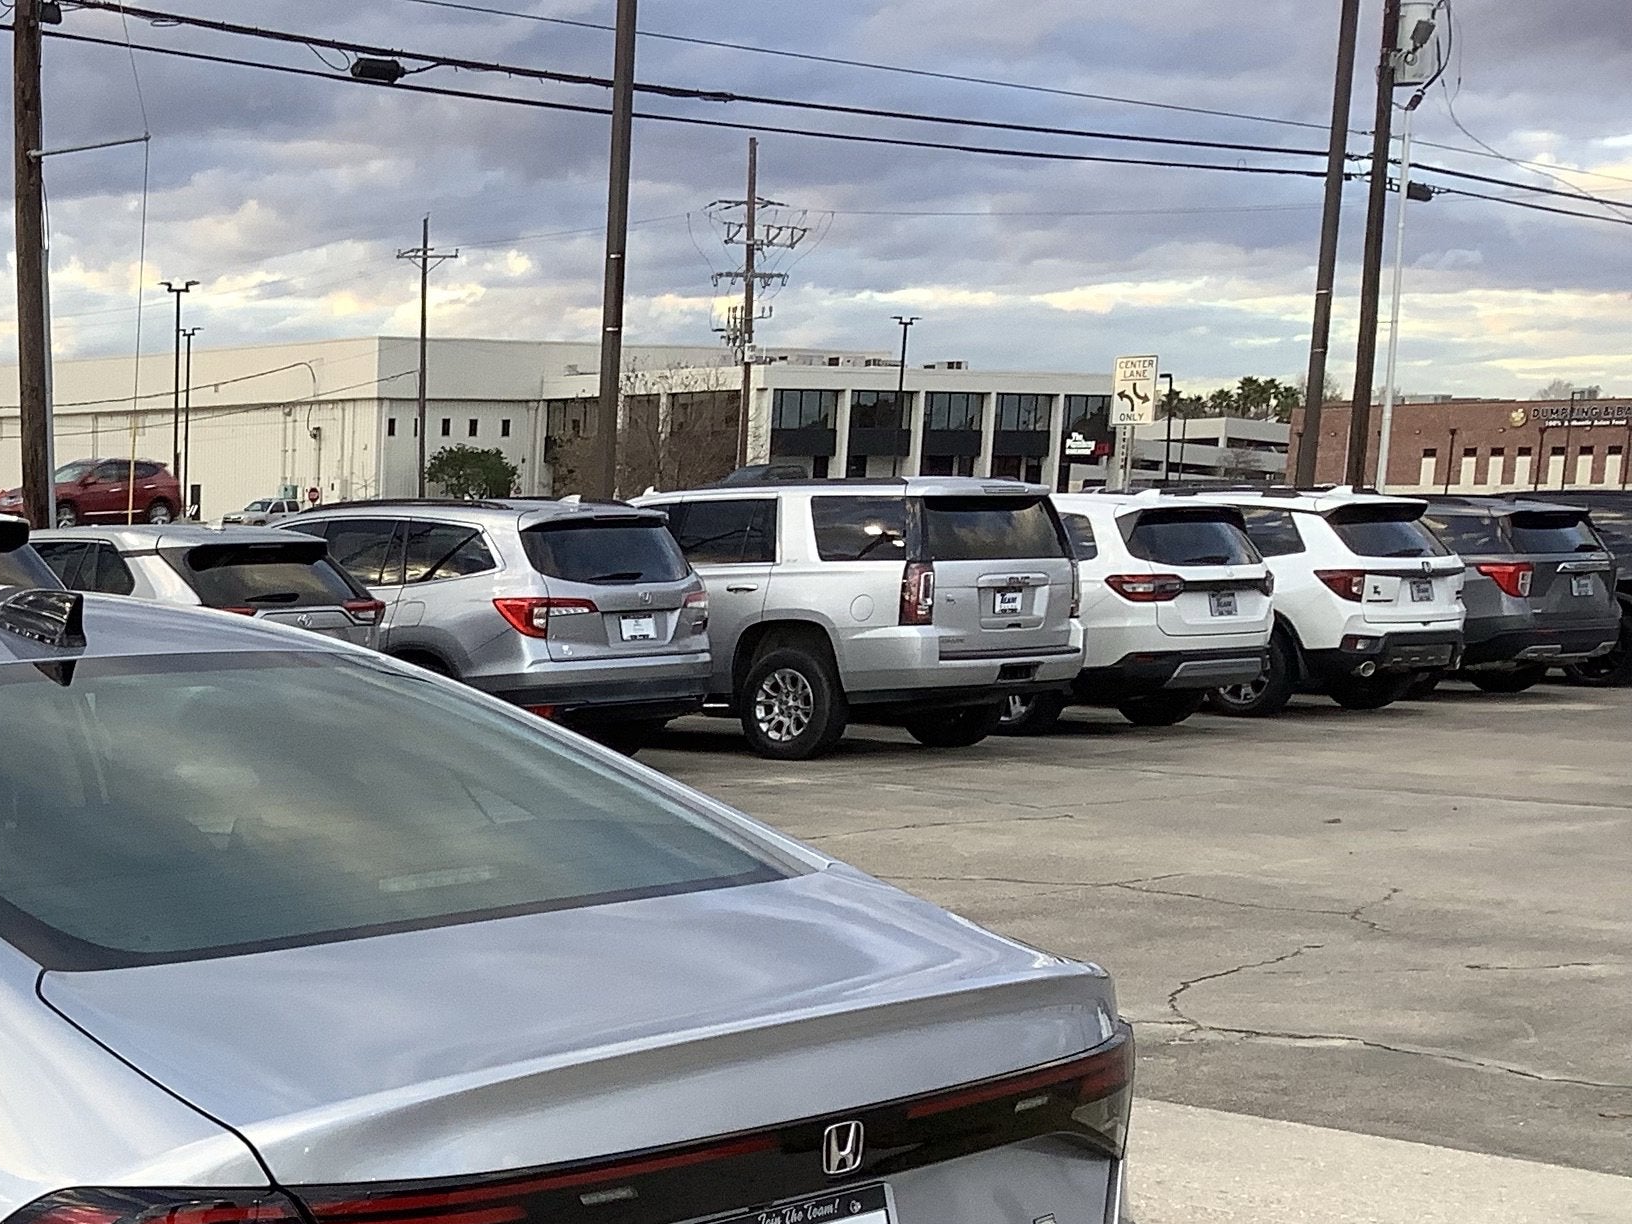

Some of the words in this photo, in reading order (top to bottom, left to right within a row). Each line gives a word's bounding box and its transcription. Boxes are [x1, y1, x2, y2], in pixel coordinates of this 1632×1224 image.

[1118, 360, 1154, 370] CENTER
[1124, 370, 1148, 378] LANE
[1603, 406, 1615, 417] &
[1119, 413, 1145, 422] ONLY
[781, 1206, 804, 1224] The
[804, 1198, 840, 1220] Team!
